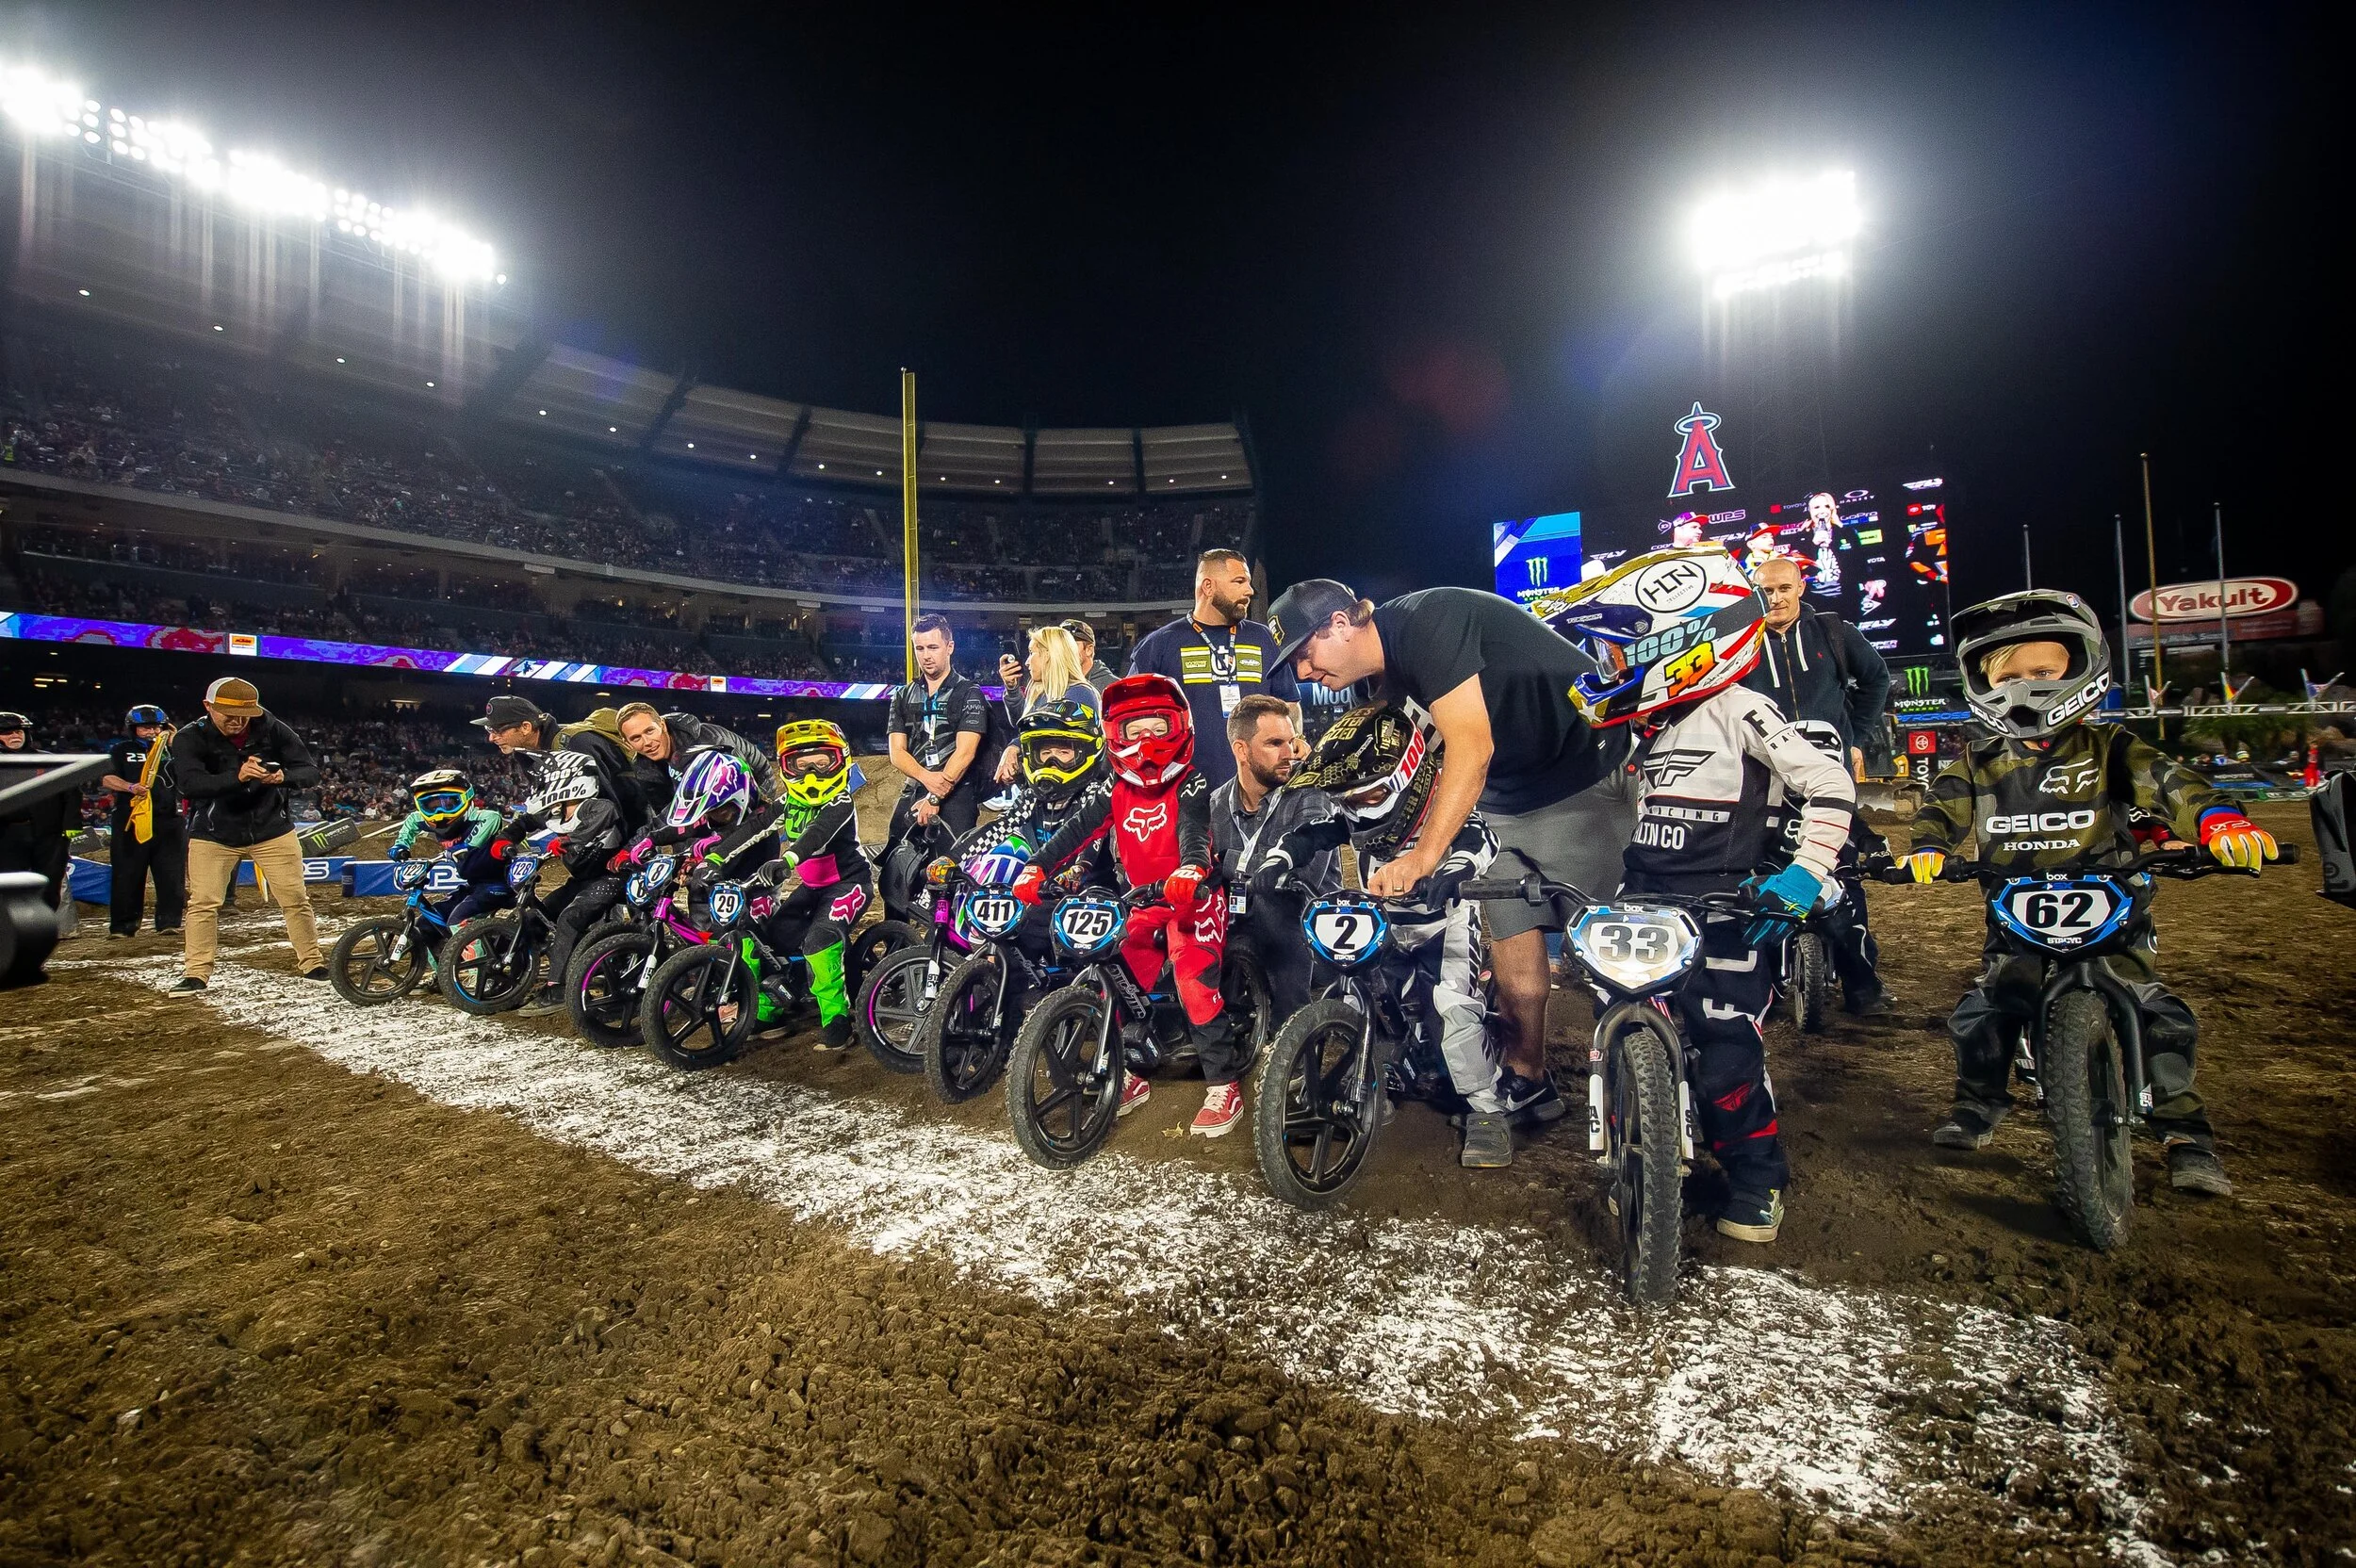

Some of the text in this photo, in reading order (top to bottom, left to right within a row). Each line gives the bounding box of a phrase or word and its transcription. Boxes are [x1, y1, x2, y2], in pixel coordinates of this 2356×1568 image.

[1709, 509, 1746, 524] WPS
[2157, 587, 2270, 612] Yakult
[1624, 614, 1717, 667] 100%
[1664, 642, 1720, 698] 33
[1894, 698, 1947, 708] MONSTER
[2046, 671, 2110, 727] GEICO
[126, 753, 147, 762] 23
[544, 765, 583, 784] 100%
[539, 783, 586, 808] 100%
[1986, 809, 2096, 834] GEICO
[2003, 838, 2081, 852] HONDA
[402, 864, 423, 877] 122
[512, 859, 532, 876] 128
[651, 864, 664, 882] 8
[2046, 872, 2068, 881] box
[717, 895, 736, 913] 29
[977, 902, 1011, 922] 411
[1623, 903, 1644, 913] box
[2025, 891, 2094, 929] 62
[1066, 911, 1110, 937] 125
[1333, 915, 1358, 950] 2
[1598, 924, 1670, 965] 33
